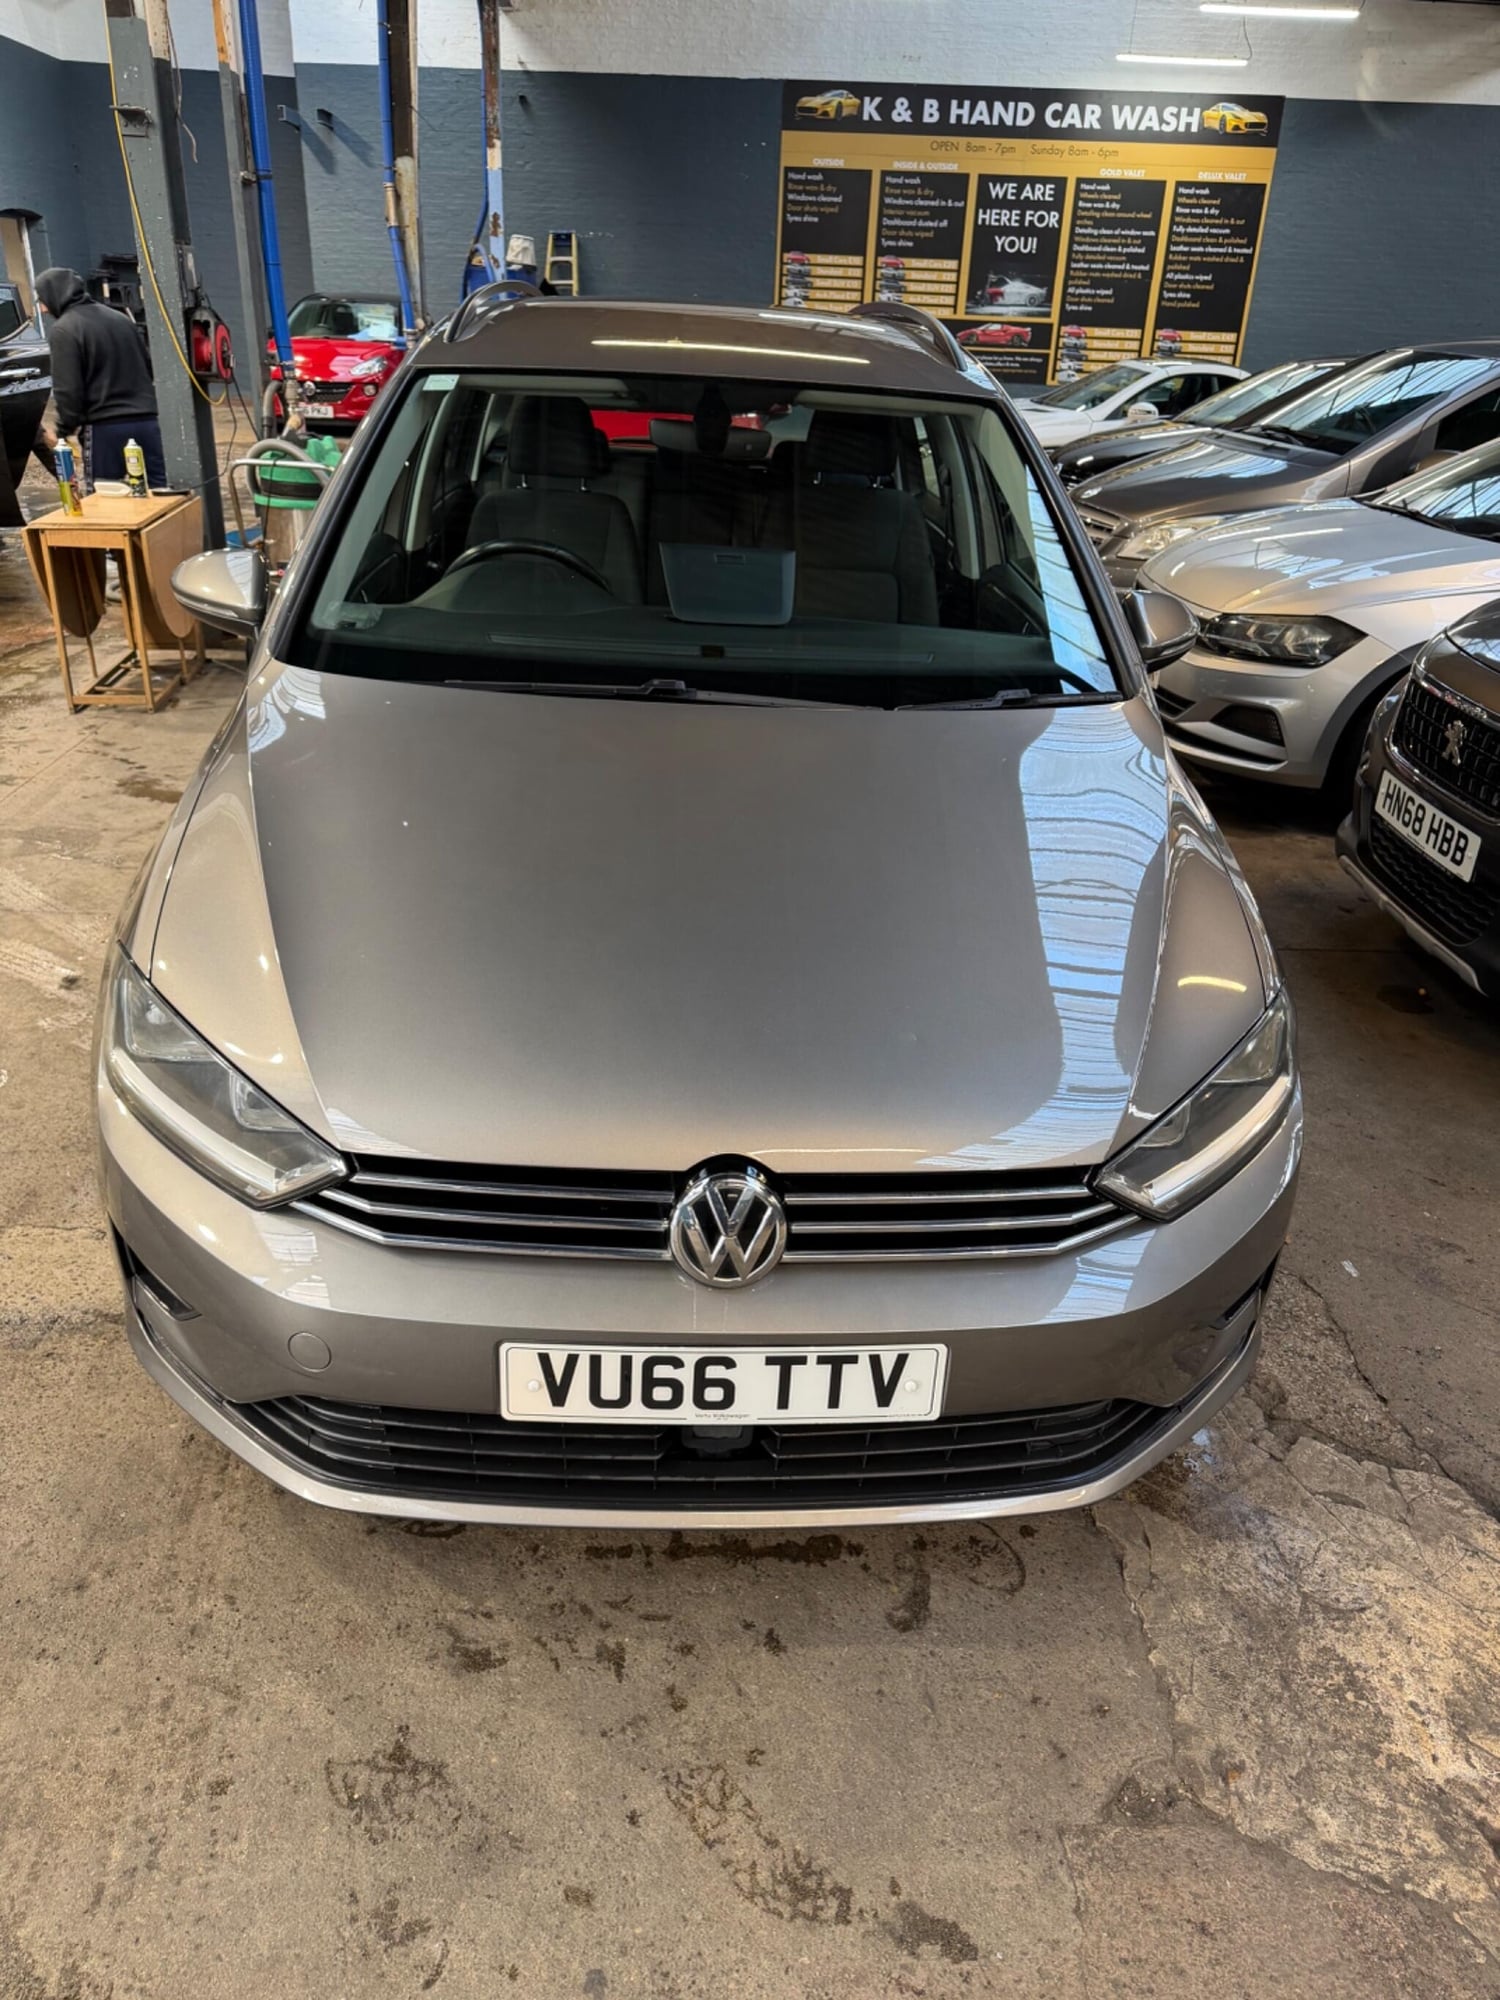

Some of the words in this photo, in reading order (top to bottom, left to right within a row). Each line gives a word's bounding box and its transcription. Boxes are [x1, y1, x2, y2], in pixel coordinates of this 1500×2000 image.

[862, 96, 883, 122] K
[891, 97, 913, 122] &
[922, 98, 940, 123] B
[949, 99, 1036, 127] HAND
[1044, 102, 1102, 129] CAR
[1111, 104, 1201, 133] WASH
[930, 140, 960, 152] OPEN
[965, 142, 986, 152] 8am
[994, 142, 1016, 156] 7pm
[1030, 144, 1066, 158] Sunday
[1068, 146, 1089, 156] 8am
[1098, 146, 1120, 159] 6pm
[988, 182, 1018, 200] WE
[1020, 183, 1056, 201] ARE
[978, 208, 1021, 226] HERE
[1024, 210, 1060, 228] FOR
[994, 235, 1038, 254] YOU!
[1382, 778, 1426, 837] HN68
[1426, 812, 1469, 867] HBB
[537, 1352, 737, 1410] VU66
[764, 1352, 910, 1410] TTV
